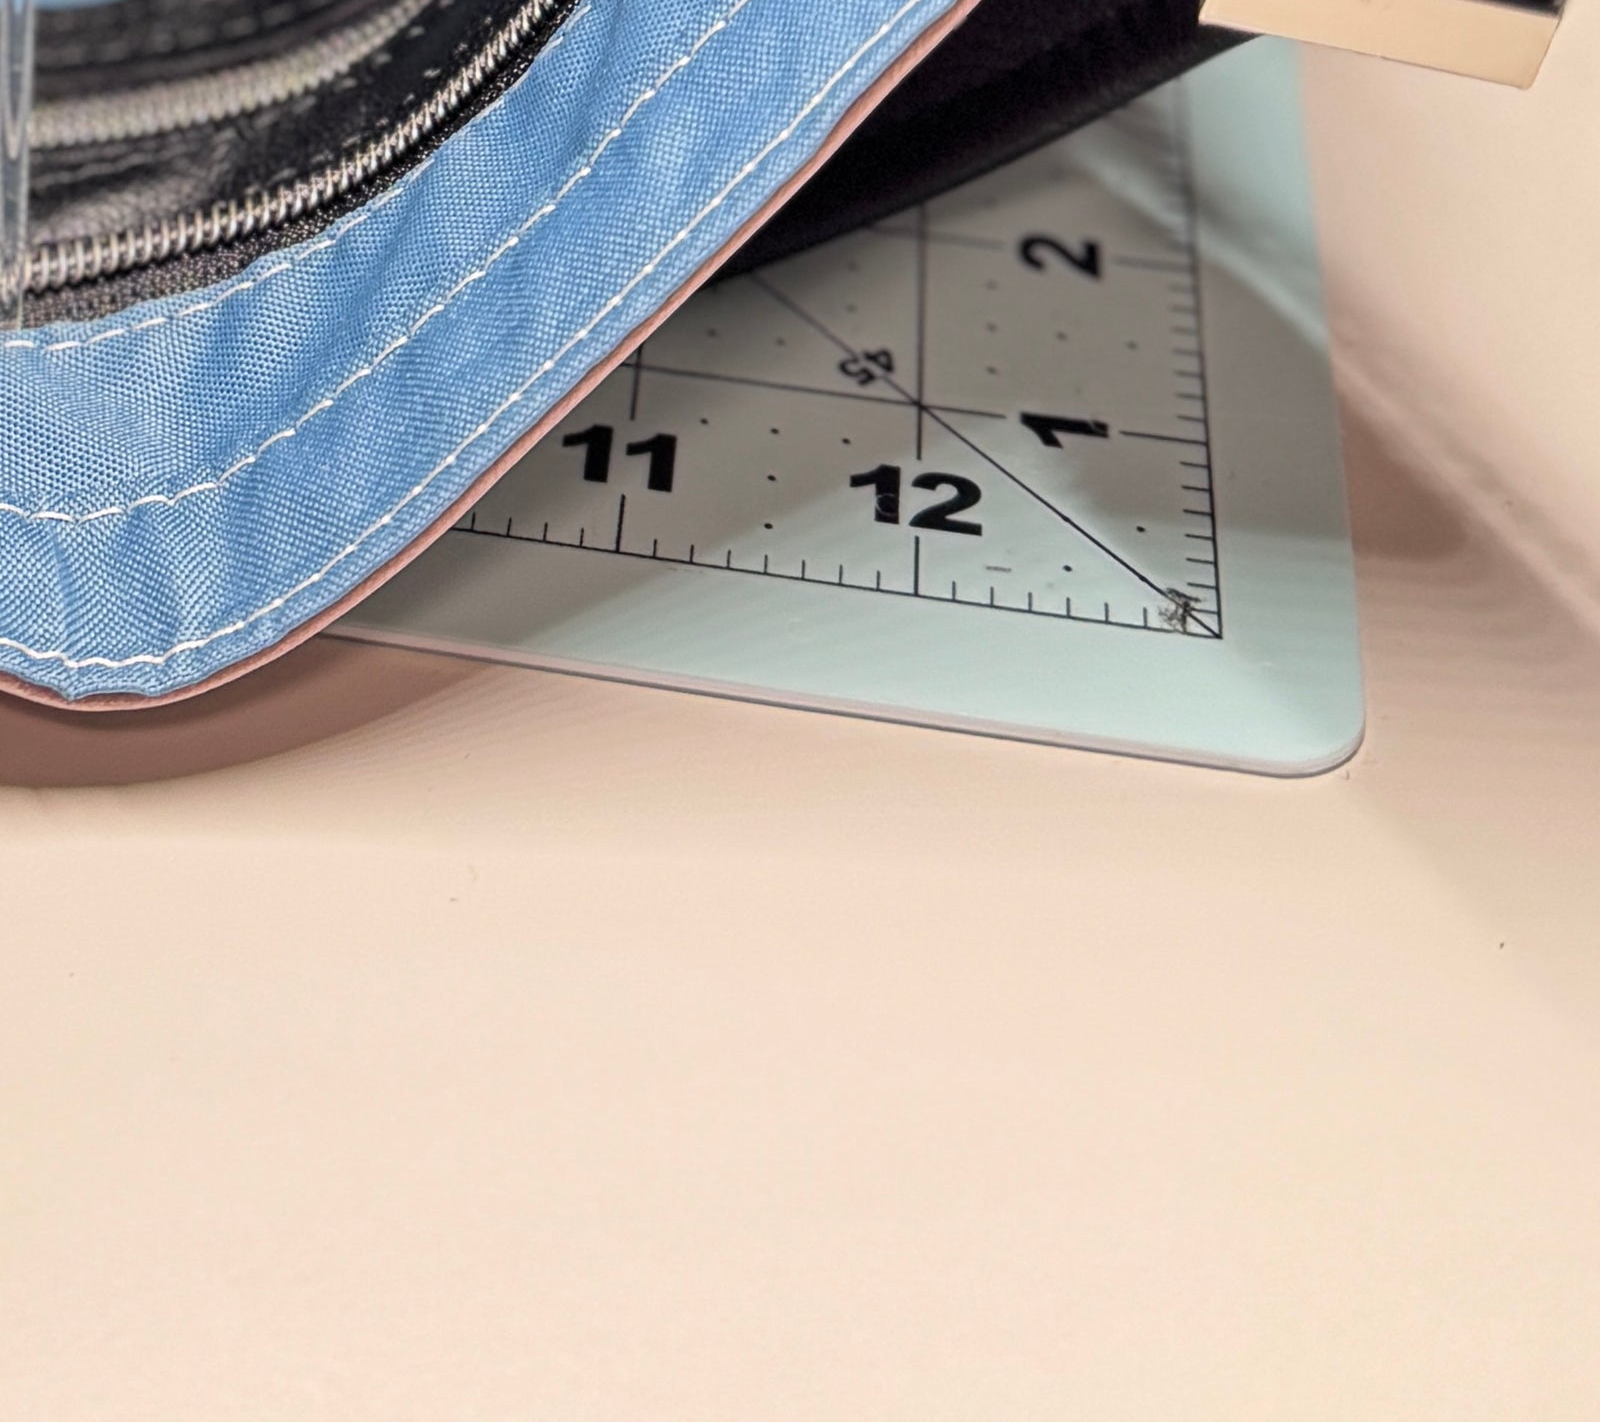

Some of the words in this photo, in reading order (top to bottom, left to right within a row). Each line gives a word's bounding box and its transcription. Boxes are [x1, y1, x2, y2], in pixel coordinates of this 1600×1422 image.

[1017, 233, 1103, 281] 2
[837, 349, 896, 387] 45
[1019, 411, 1110, 450] 1
[560, 423, 679, 493] 11
[848, 463, 983, 537] 12
